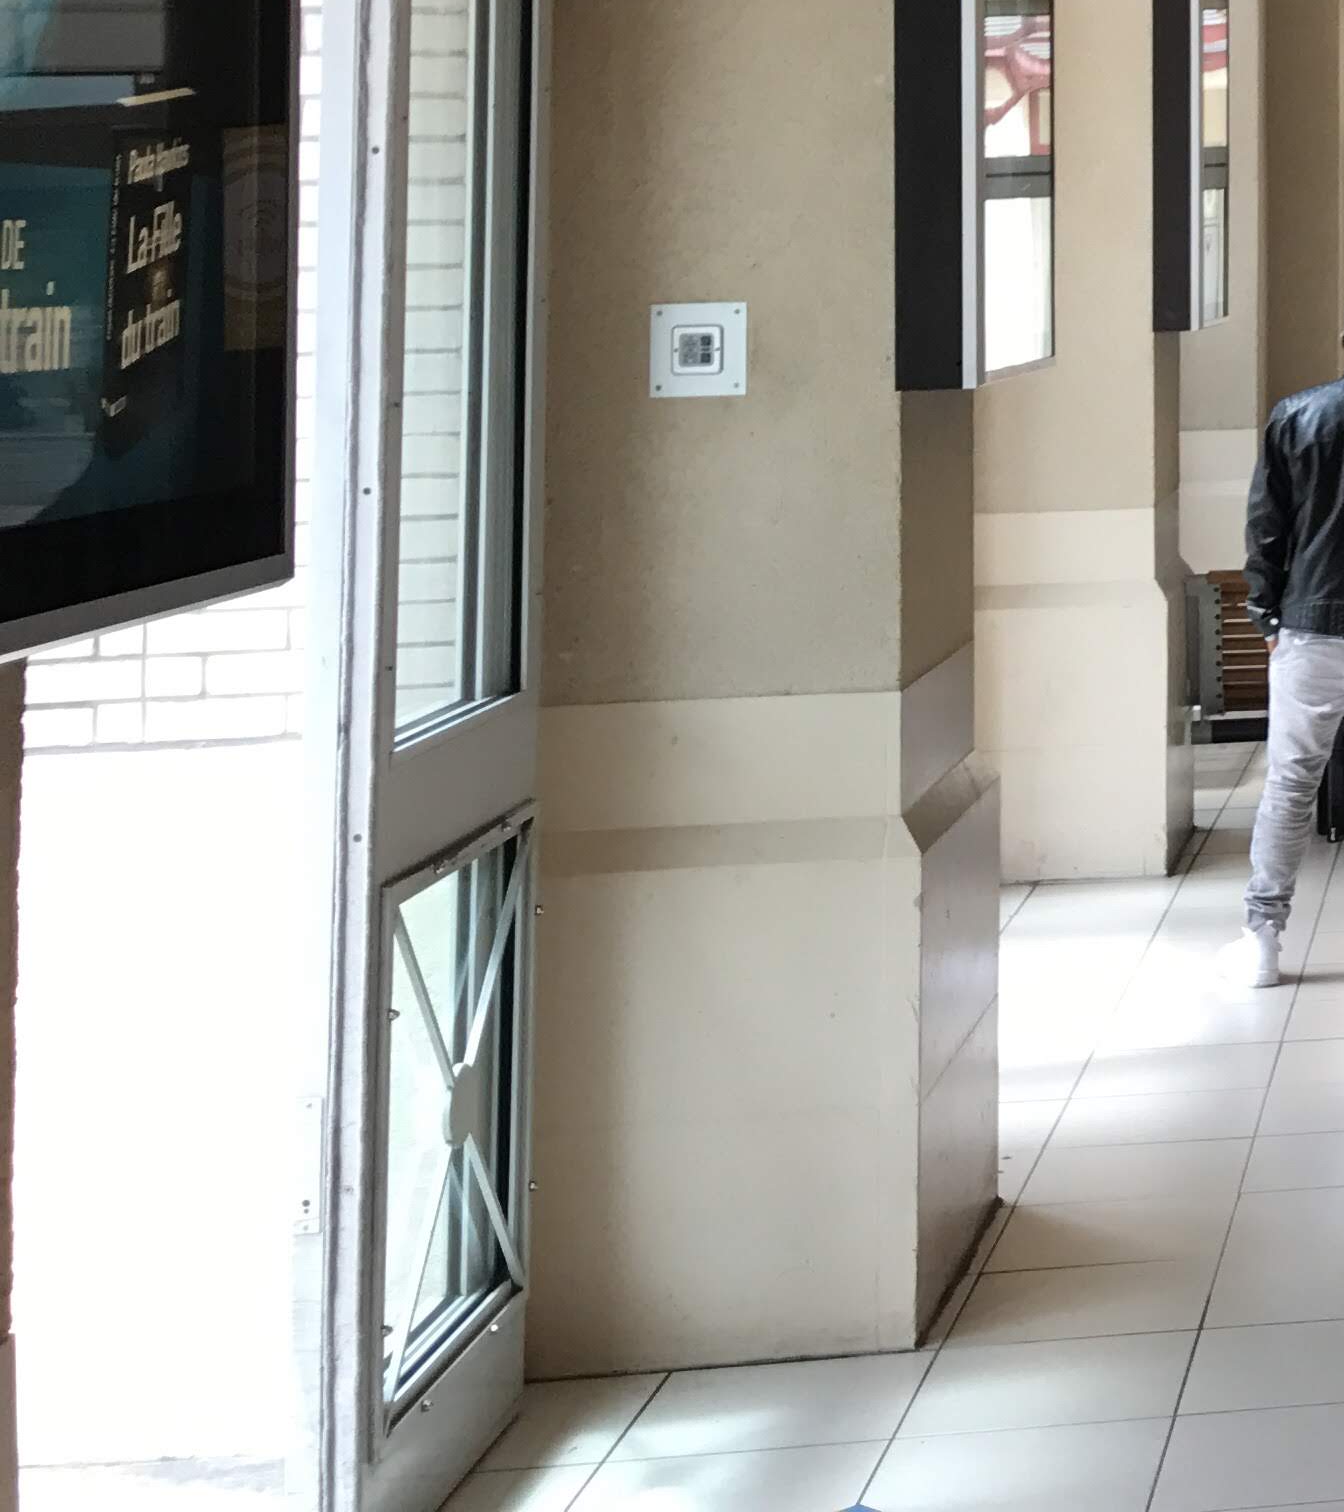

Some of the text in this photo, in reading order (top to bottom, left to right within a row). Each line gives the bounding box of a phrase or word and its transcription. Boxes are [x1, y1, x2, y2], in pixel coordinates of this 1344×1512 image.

[0, 219, 27, 270] DE
[126, 214, 149, 275] La
[145, 288, 181, 355] train
